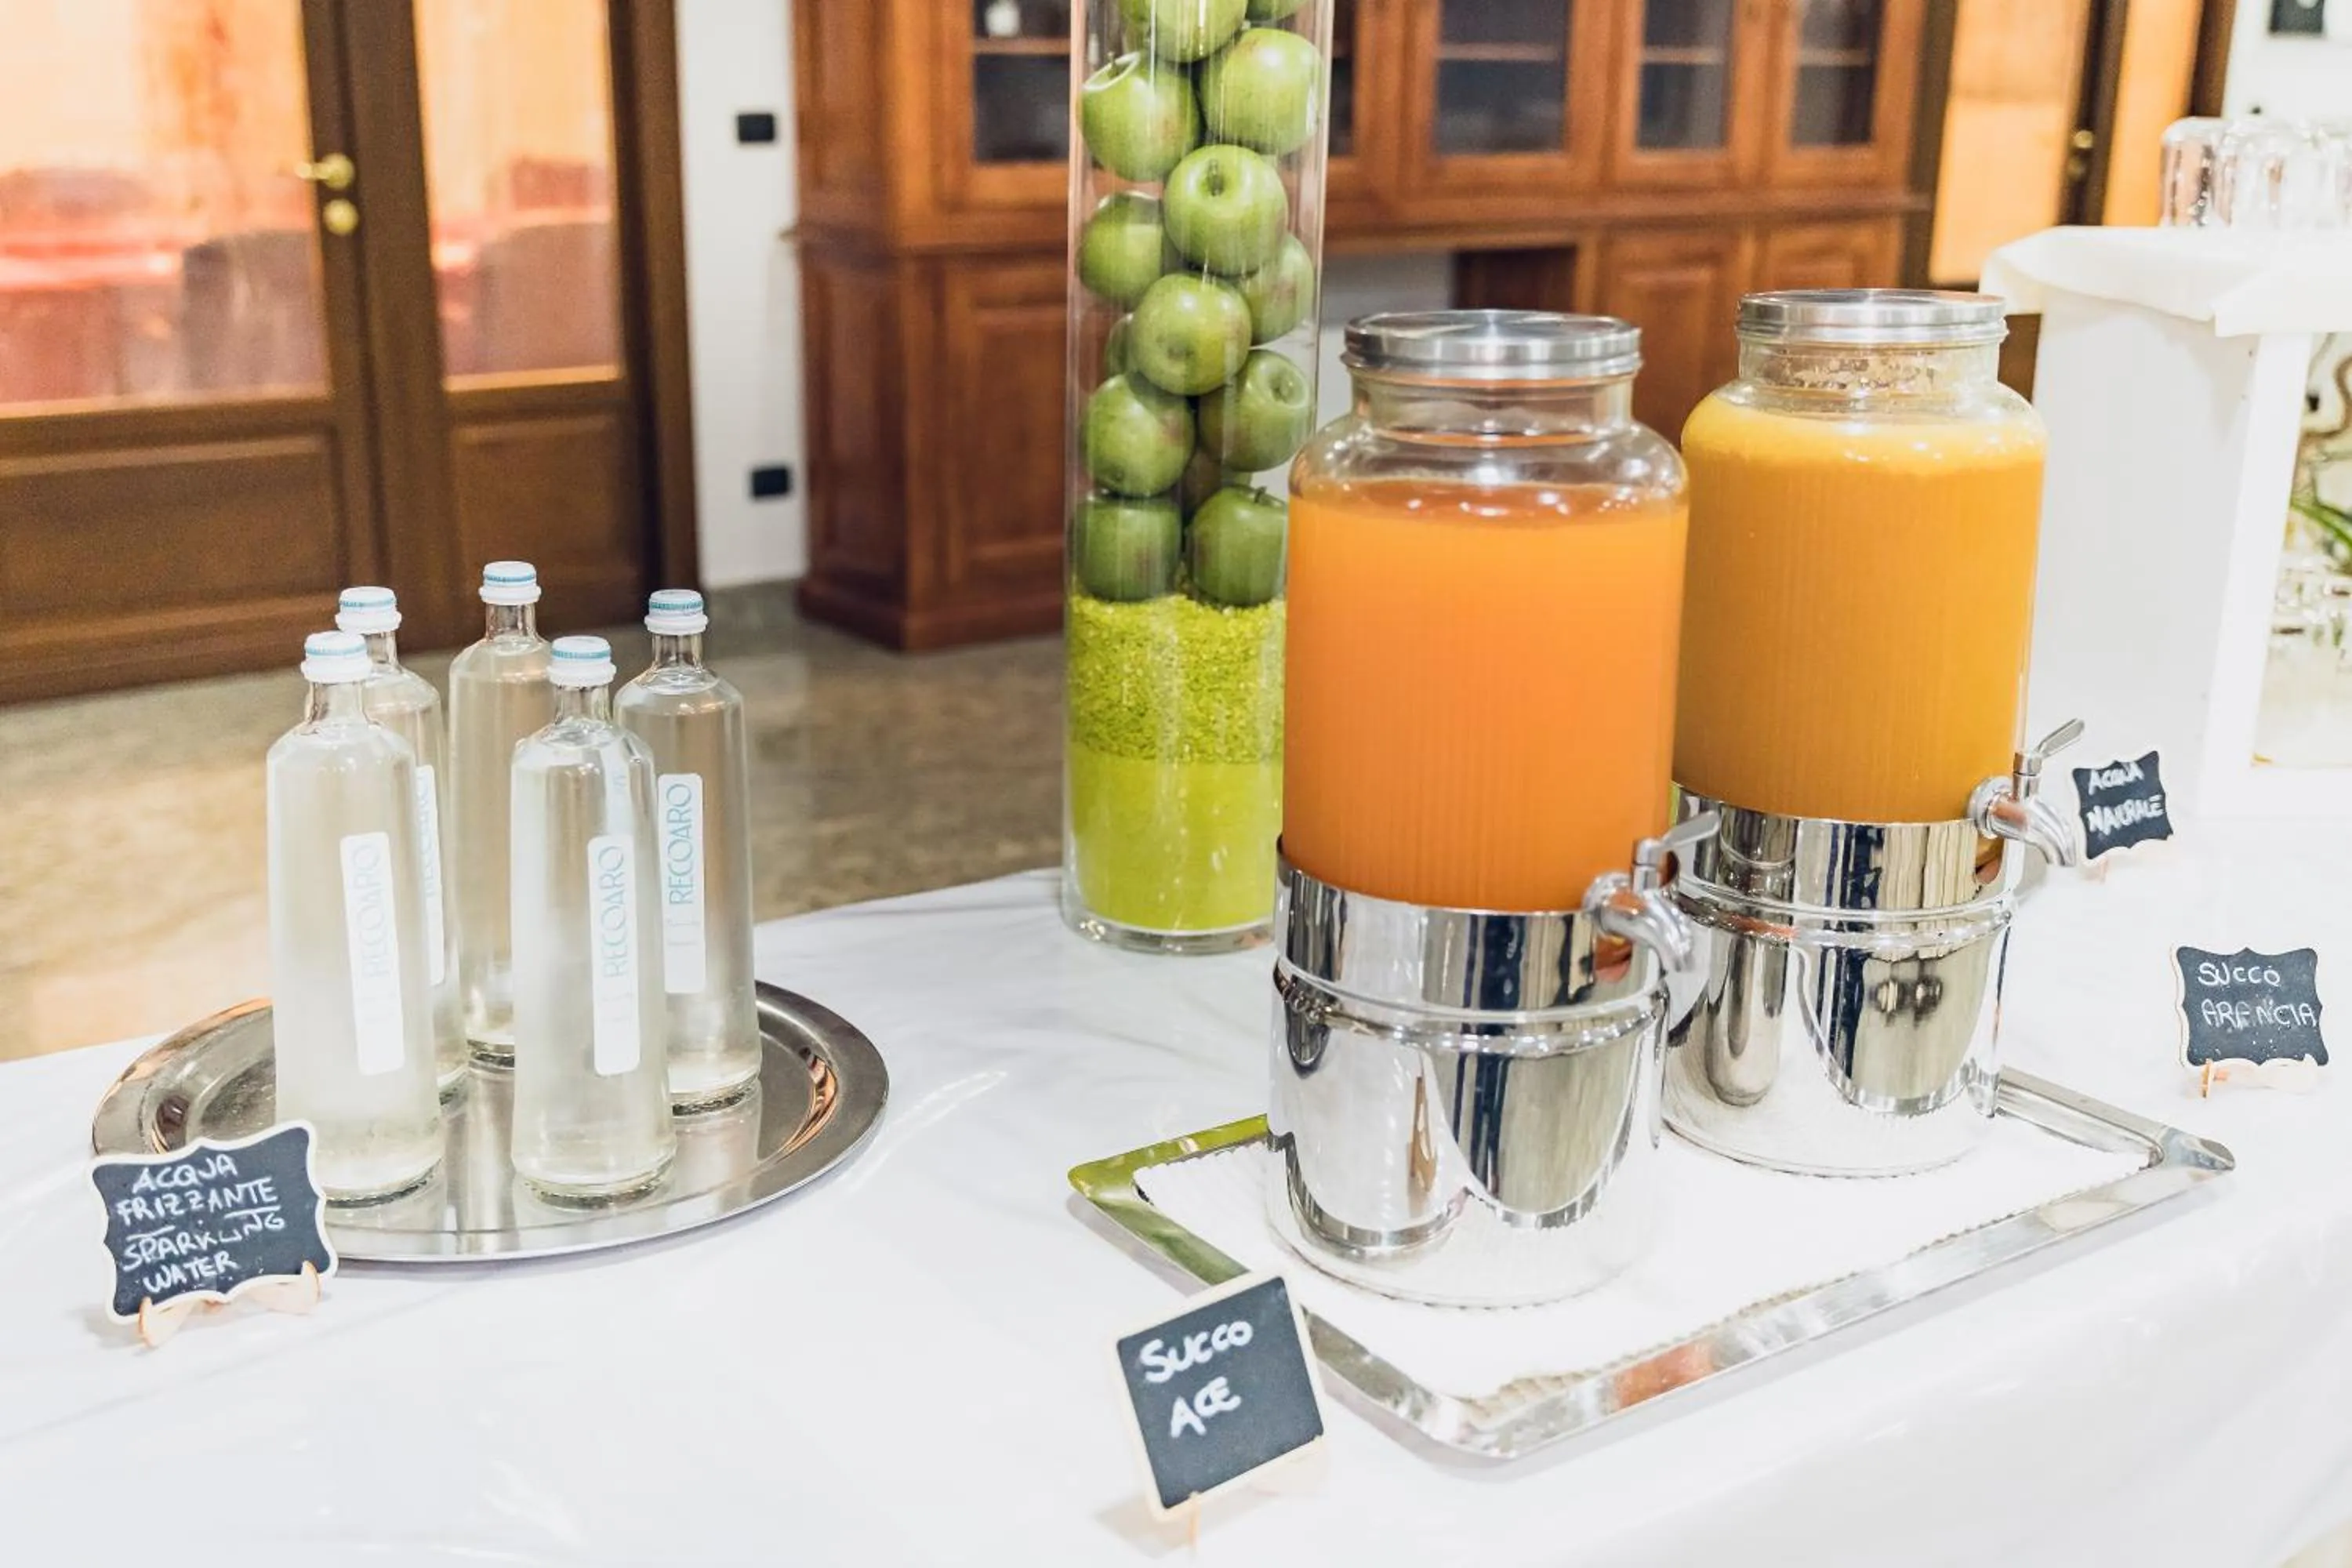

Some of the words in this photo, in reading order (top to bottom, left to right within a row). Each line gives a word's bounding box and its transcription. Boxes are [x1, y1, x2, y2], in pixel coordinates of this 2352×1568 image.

[666, 783, 694, 905] RECOARO
[354, 844, 391, 978] RECOARO
[598, 845, 629, 978] RECOARO
[2198, 961, 2281, 987] SUCCO
[117, 1176, 279, 1225] FRIZZANTE
[132, 1153, 238, 1193] ACQUA
[122, 1213, 285, 1272] SPARKLING
[142, 1250, 241, 1293] WATER
[1169, 1376, 1243, 1439] ACE
